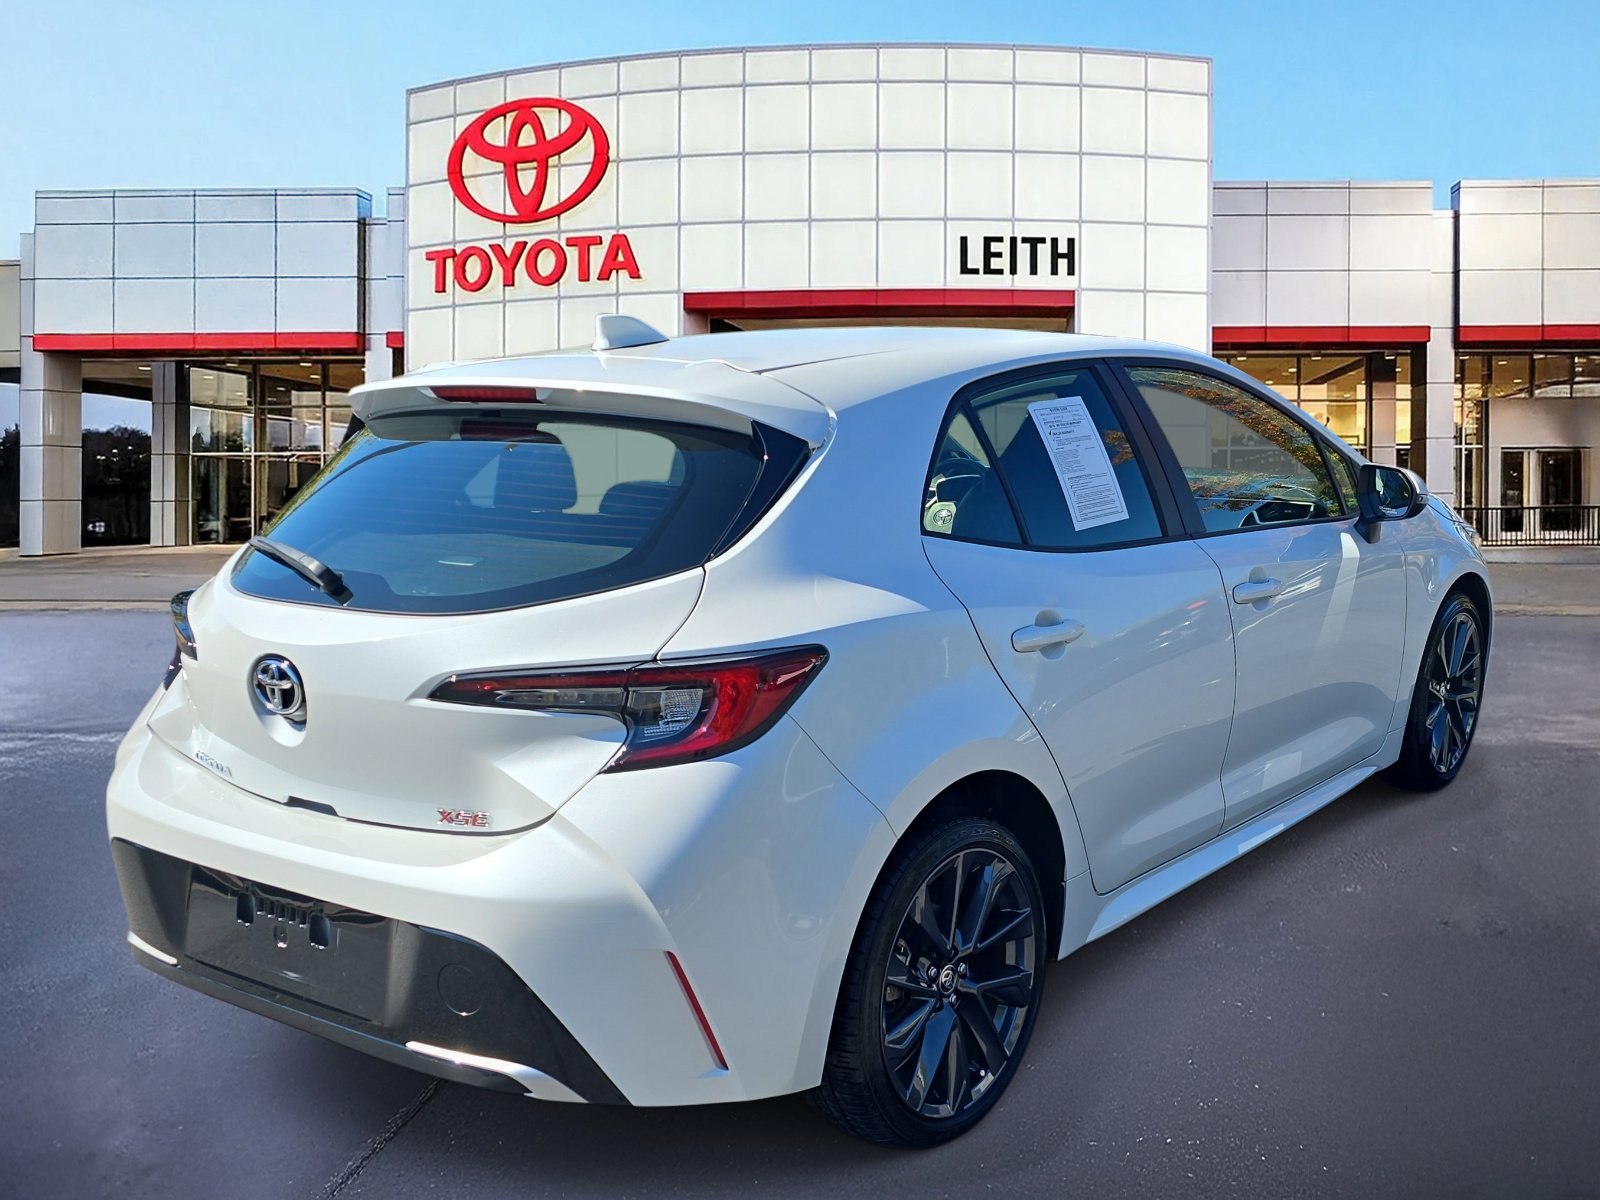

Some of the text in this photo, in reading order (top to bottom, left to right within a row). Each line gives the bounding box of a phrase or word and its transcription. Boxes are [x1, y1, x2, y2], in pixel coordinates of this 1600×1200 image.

[425, 233, 642, 293] TOYOTA
[960, 236, 1075, 276] LEITH
[436, 808, 491, 828] XSE
